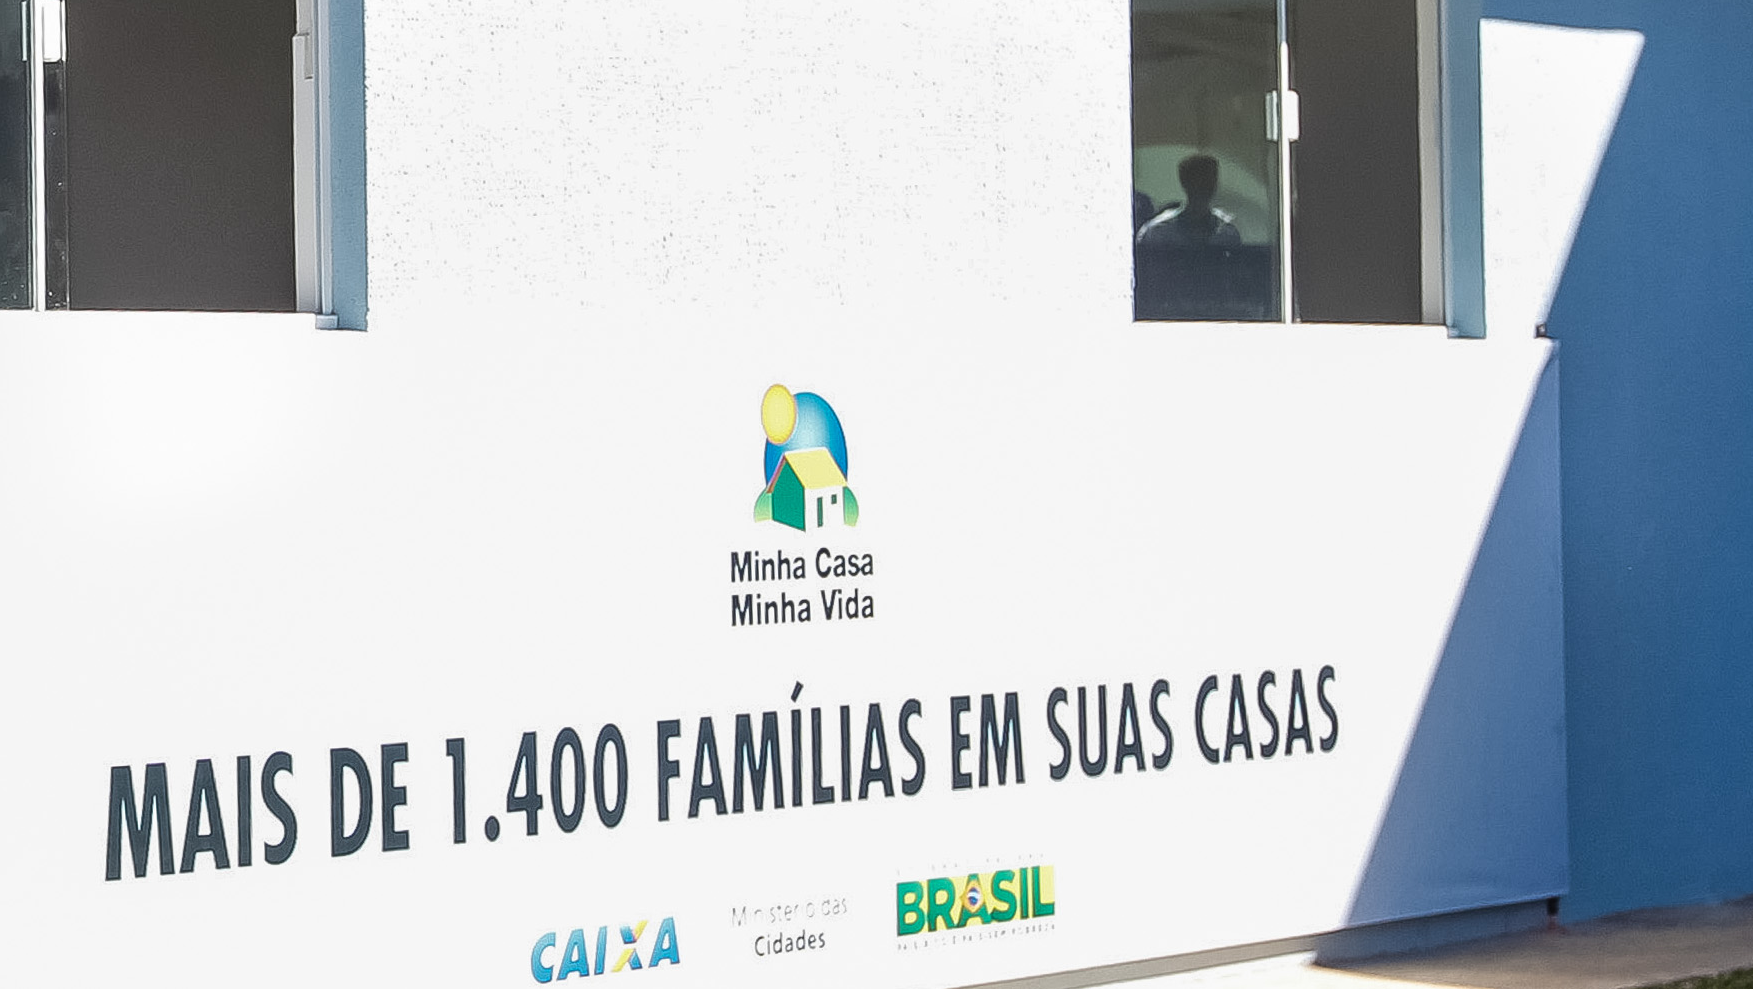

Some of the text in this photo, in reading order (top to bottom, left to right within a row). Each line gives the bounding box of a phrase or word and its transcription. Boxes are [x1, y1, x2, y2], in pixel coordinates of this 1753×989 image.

[730, 547, 874, 583] Minha Casa
[731, 588, 875, 627] Minha Vida
[104, 664, 1339, 882] MAIS DE 1.400 FAMÍLIAS EM SUAS CASAS
[896, 865, 1056, 937] BRASIL
[530, 916, 681, 985] CAIXA
[754, 929, 826, 957] Cidades
